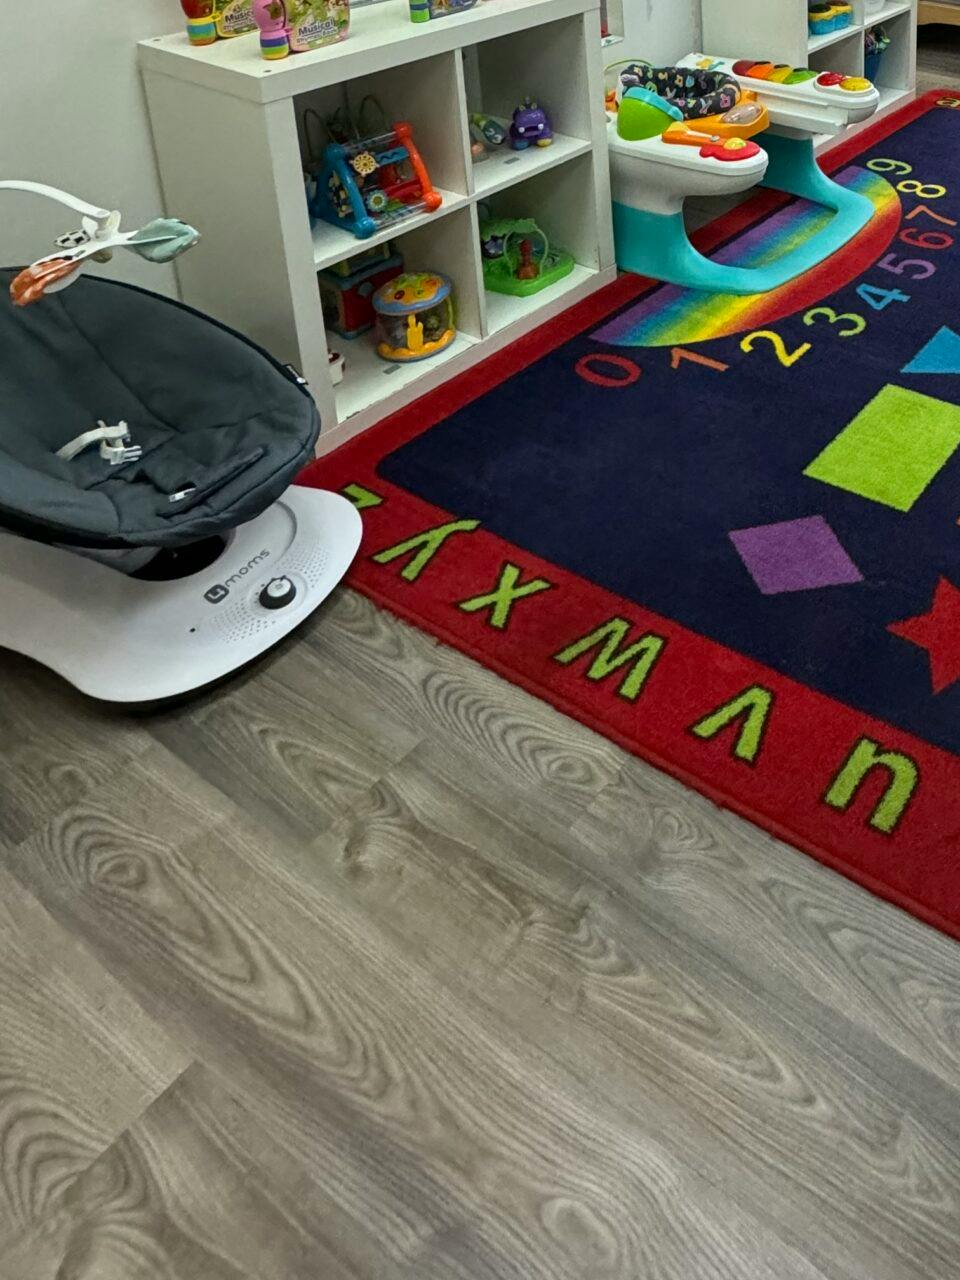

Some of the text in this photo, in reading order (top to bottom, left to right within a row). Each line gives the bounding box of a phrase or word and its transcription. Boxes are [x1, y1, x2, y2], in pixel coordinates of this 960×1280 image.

[298, 17, 334, 36] Musical
[574, 157, 958, 388] 0 1 2 3 4 5 6 7 8 9
[370, 518, 483, 582] y
[456, 562, 552, 630] x
[553, 617, 667, 704] w
[690, 685, 773, 765] v
[823, 736, 919, 835] u
